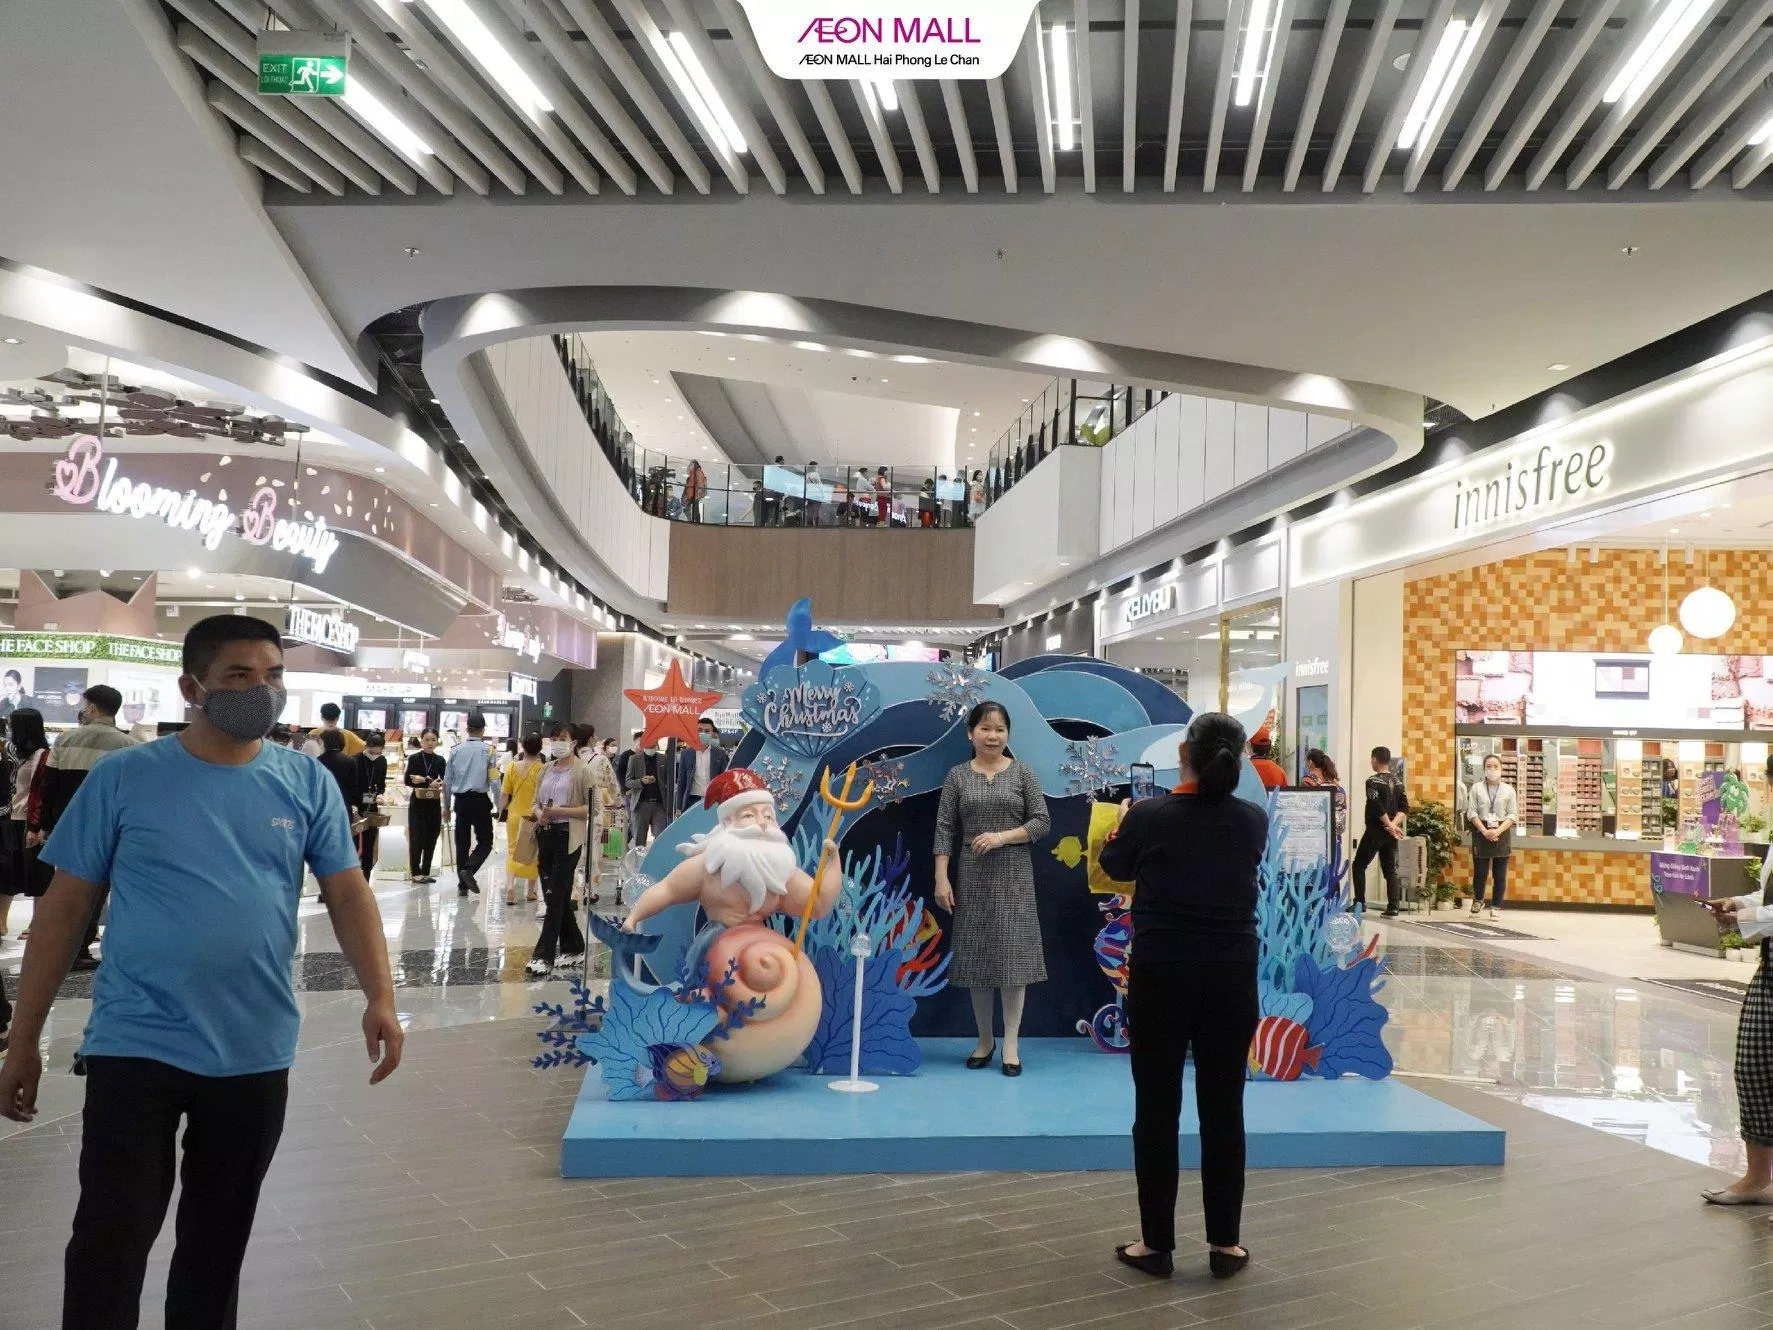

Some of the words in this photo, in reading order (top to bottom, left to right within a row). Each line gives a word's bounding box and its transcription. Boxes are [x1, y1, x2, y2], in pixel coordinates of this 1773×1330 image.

[262, 63, 288, 73] EXIT
[1454, 444, 1606, 530] innisfree
[54, 434, 236, 551] Blooming
[242, 486, 339, 574] Beauty
[1295, 657, 1330, 677] innisfree
[672, 704, 701, 716] MALL
[764, 689, 862, 734] Christmas
[782, 682, 842, 713] Merry
